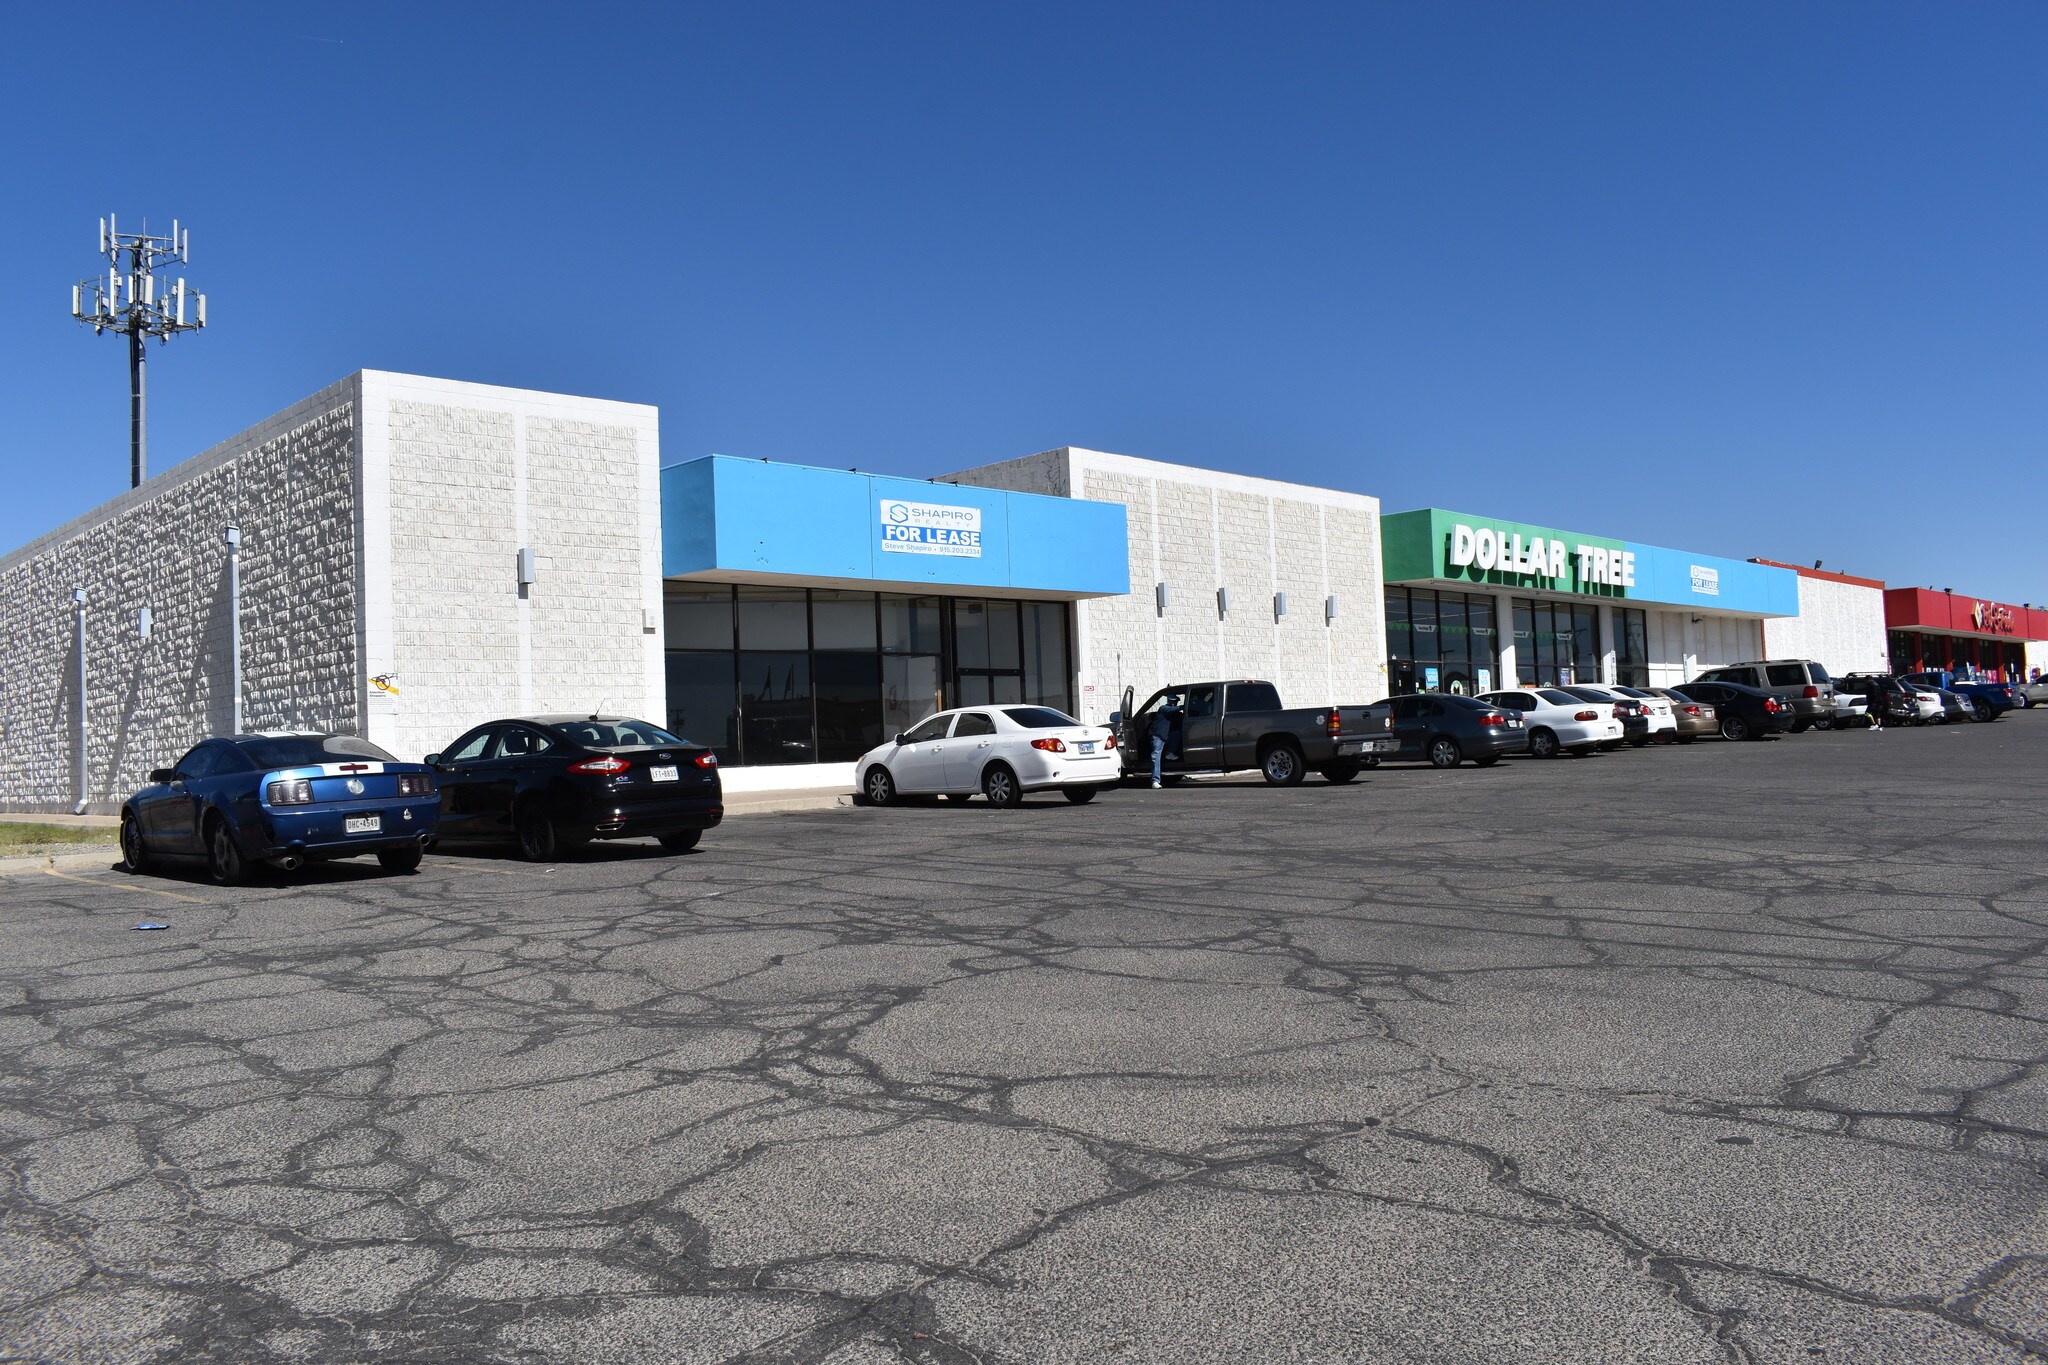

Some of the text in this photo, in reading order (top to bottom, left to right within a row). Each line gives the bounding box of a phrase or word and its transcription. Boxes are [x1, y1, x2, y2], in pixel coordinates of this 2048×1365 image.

[912, 508, 973, 521] SHAPIRO
[915, 519, 970, 527] REALTY
[886, 525, 980, 546] FOR LEASE
[906, 544, 932, 553] Shapiro
[1450, 524, 1635, 587] DOLLAR TREE
[1692, 578, 1703, 587] FOR
